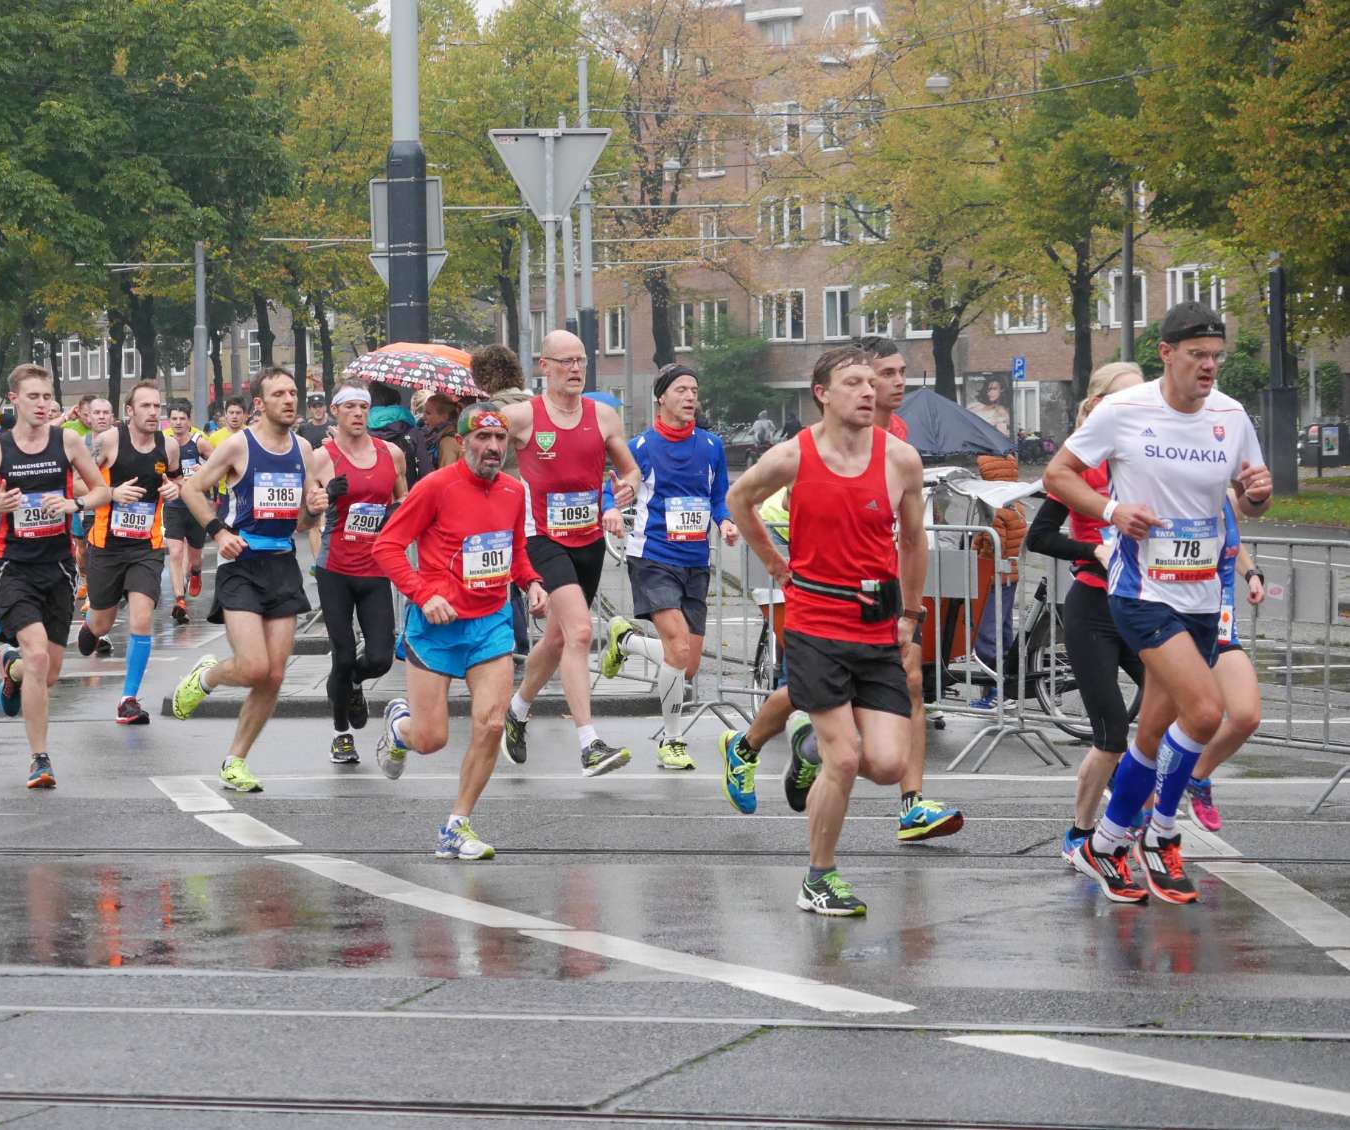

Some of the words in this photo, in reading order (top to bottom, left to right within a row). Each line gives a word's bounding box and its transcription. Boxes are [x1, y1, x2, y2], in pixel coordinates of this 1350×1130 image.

[1016, 360, 1023, 369] P
[1144, 444, 1227, 464] SLOVAKIA
[12, 460, 58, 470] MANCHESTER
[8, 468, 62, 477] FRONTRUNNERS
[267, 488, 294, 502] 3185
[122, 512, 147, 526] 3019
[560, 506, 590, 521] 1093
[680, 512, 702, 525] 1745
[352, 514, 380, 529] 2901
[1155, 530, 1176, 538] TATA
[468, 544, 485, 552] TATA
[1172, 540, 1201, 558] 778
[482, 550, 504, 568] 901
